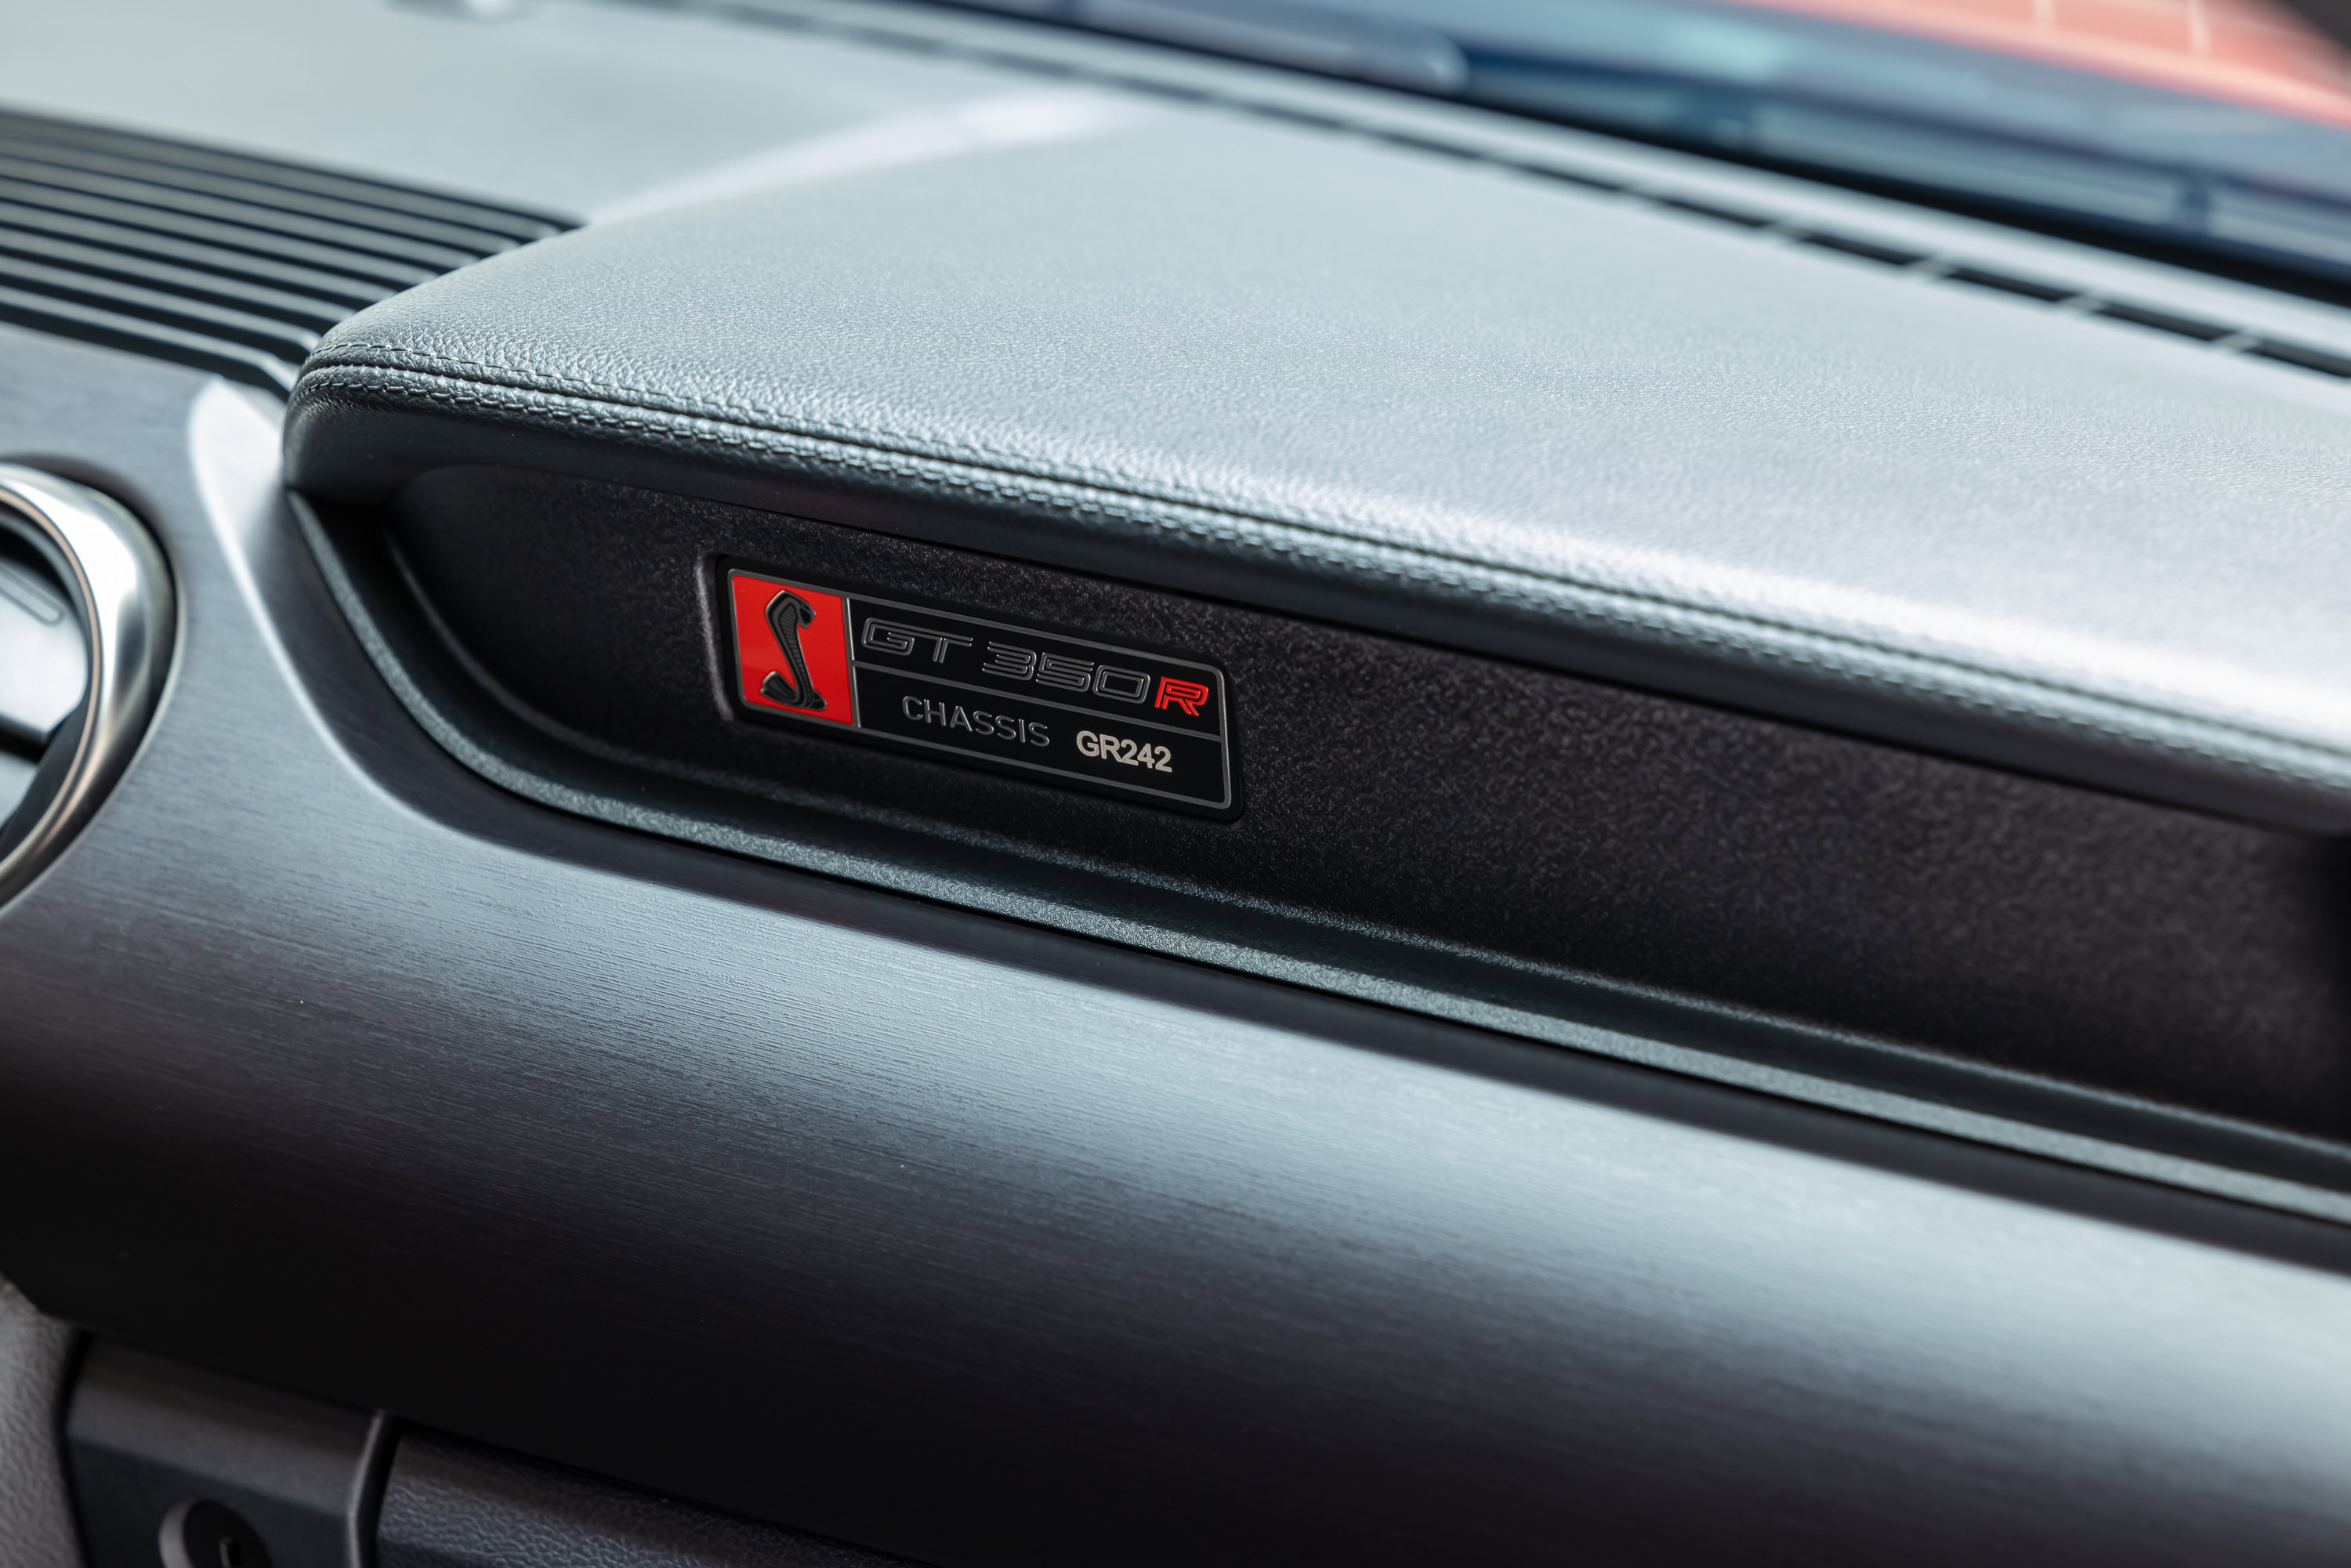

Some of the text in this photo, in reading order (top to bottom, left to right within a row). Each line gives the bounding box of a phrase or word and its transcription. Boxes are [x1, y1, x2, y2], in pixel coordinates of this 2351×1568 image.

[861, 617, 973, 664] GT
[902, 695, 1173, 773] CHASSIS GR242
